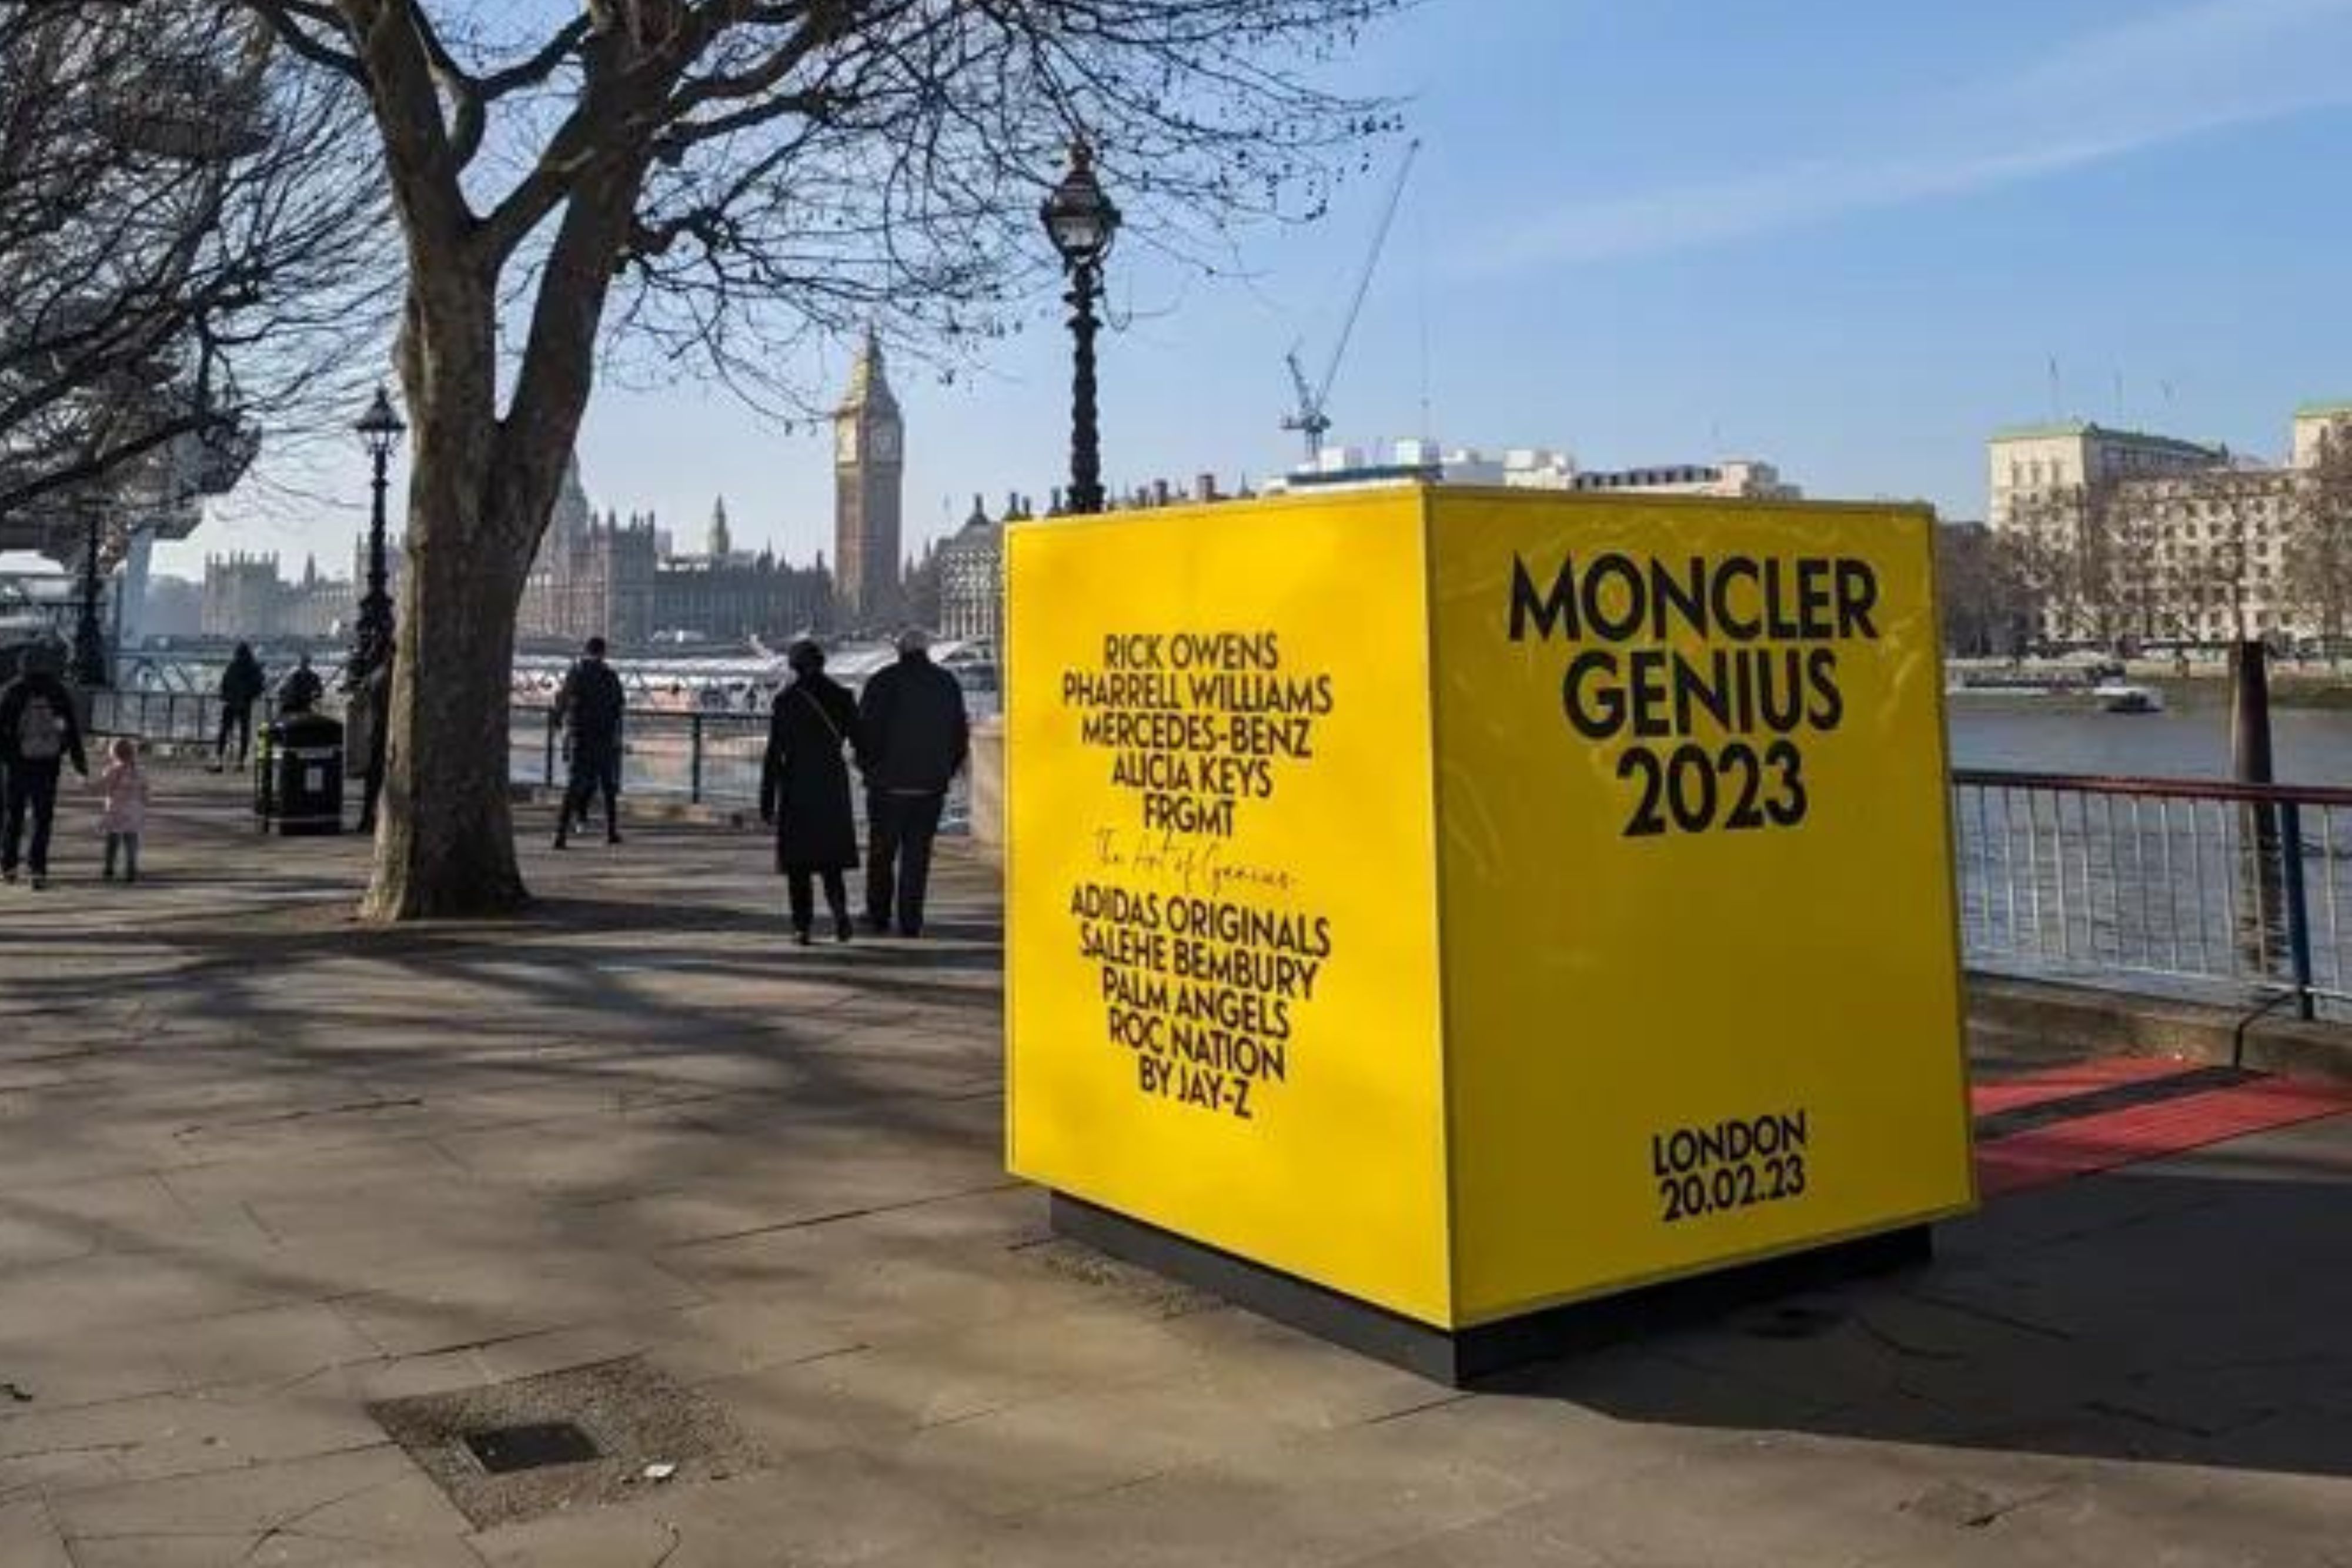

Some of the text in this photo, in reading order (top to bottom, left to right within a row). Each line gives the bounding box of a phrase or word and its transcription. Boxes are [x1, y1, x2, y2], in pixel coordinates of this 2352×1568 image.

[1509, 550, 1879, 641] MONCLER
[1104, 633, 1278, 670] RICK OWENS
[1063, 672, 1334, 714] PHARRELL WILLIAMS
[1562, 647, 1844, 740] GENIUS
[1082, 713, 1313, 758] MERCEDES-BENZ
[1111, 754, 1273, 798] ALICIA KEYS
[1616, 740, 1808, 838] 2023
[1142, 794, 1237, 838] FRGMT
[1070, 883, 1331, 958] ADIDAS ORIGINALS
[1081, 922, 1319, 999] SALEHE BEMBURY
[1102, 966, 1290, 1039] PALM ANGELS
[1108, 1006, 1285, 1082] ROC NATION
[1139, 1055, 1252, 1119] BY JAY-Z
[1653, 1109, 1806, 1176] LONDON
[1659, 1154, 1806, 1222] 20.02.23
